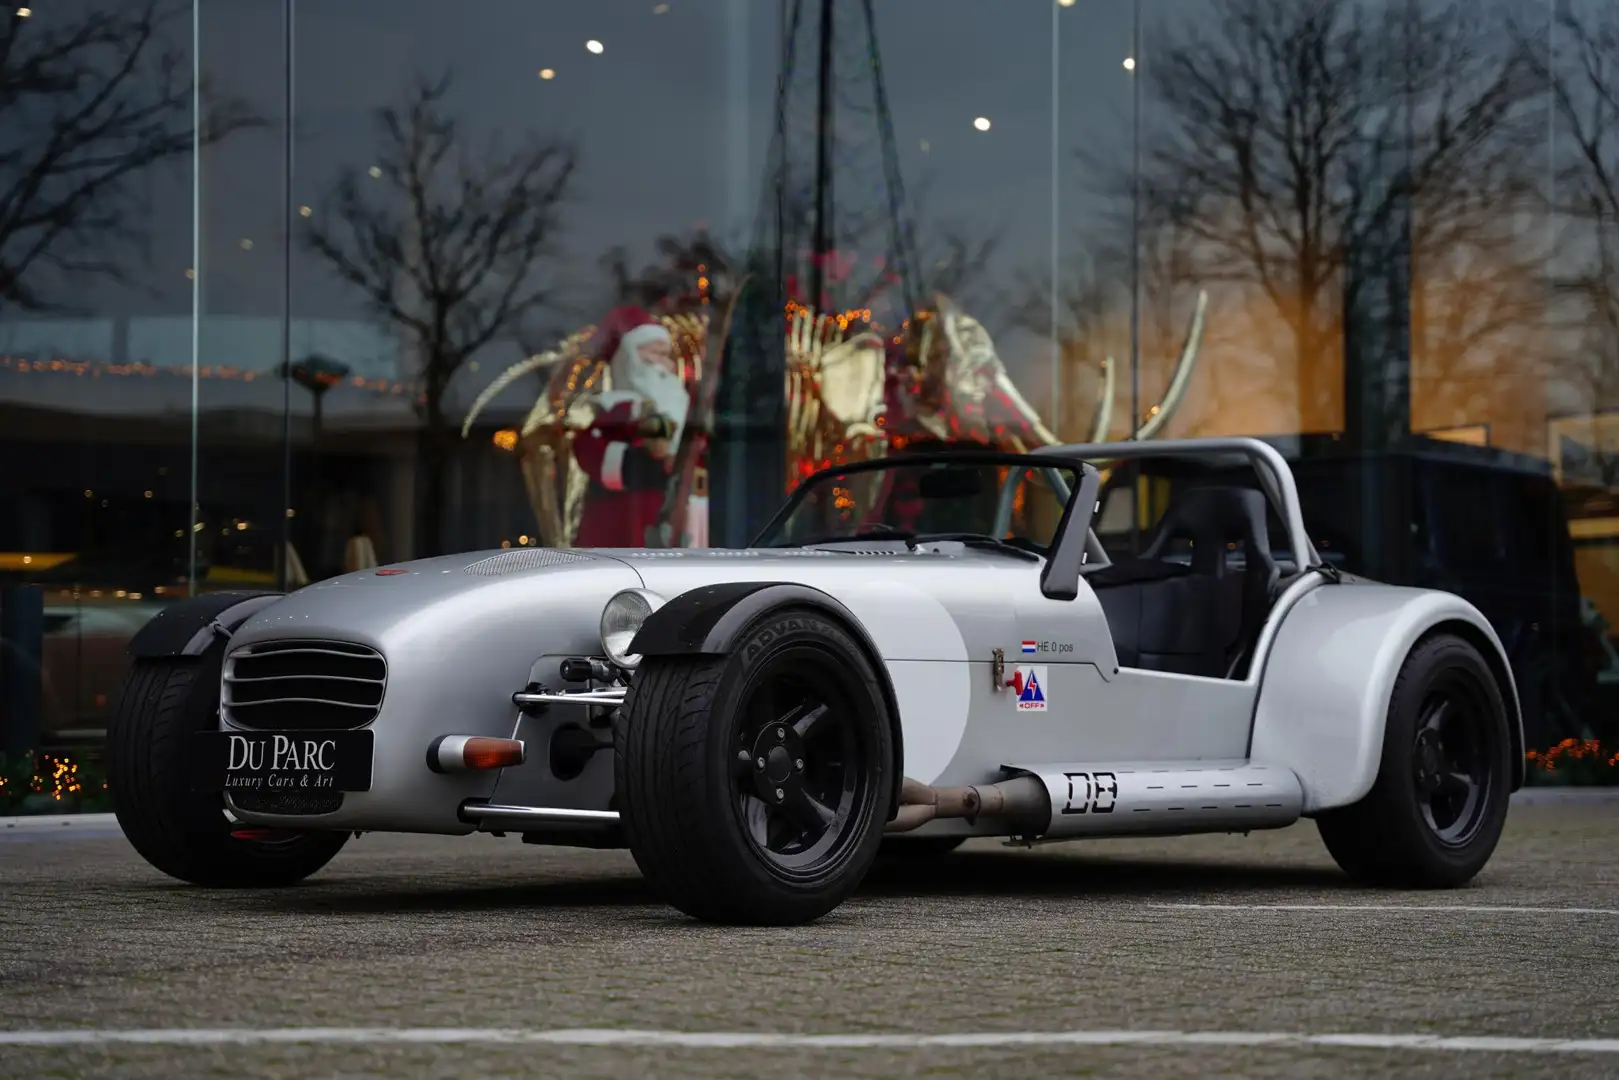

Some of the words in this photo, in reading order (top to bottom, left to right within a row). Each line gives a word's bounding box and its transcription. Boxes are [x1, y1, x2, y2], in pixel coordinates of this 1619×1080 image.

[747, 618, 819, 662] ADVAN
[1059, 643, 1074, 654] pos
[225, 773, 263, 790] Luxury
[268, 773, 295, 787] Cars
[300, 773, 309, 787] &
[314, 774, 334, 787] Art
